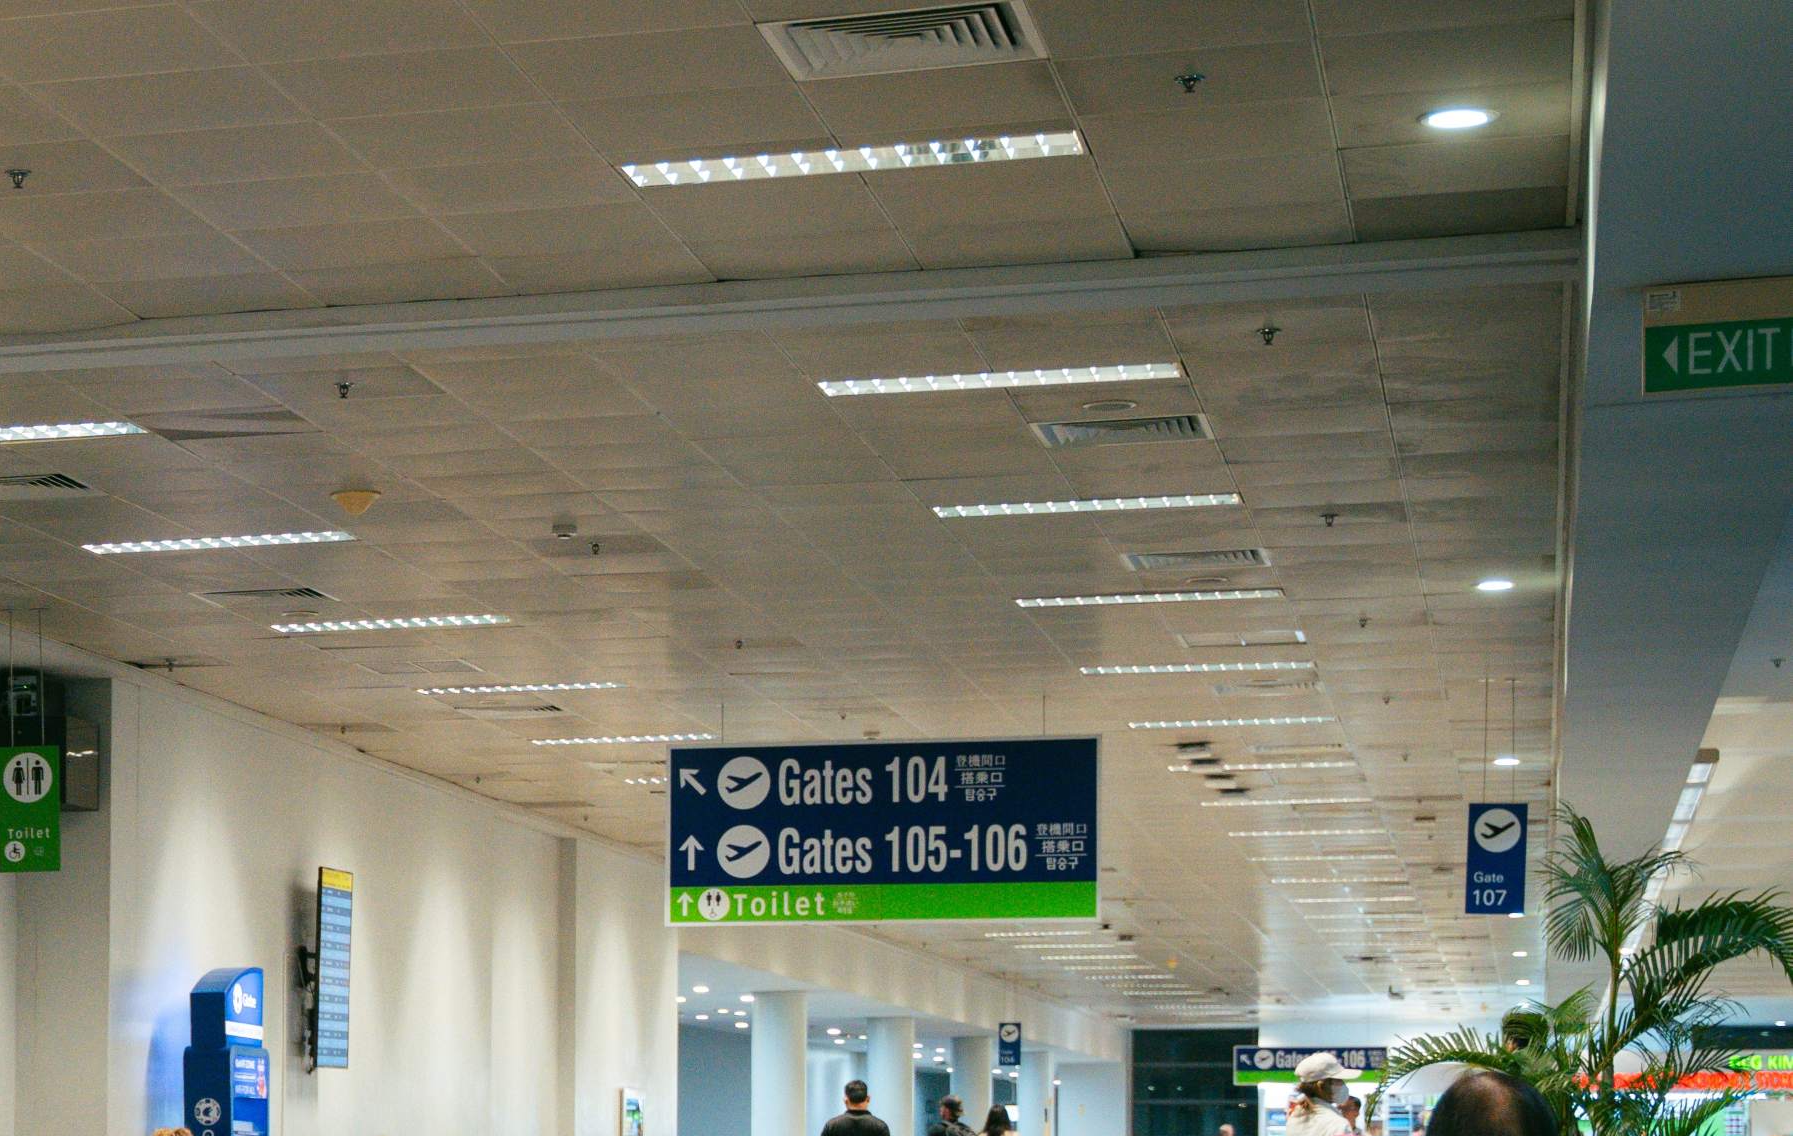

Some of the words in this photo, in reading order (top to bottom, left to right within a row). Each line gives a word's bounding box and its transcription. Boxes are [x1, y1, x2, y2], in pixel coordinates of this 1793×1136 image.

[1688, 327, 1781, 375] EXIT
[778, 757, 873, 806] Gates
[885, 755, 948, 803] 104
[7, 827, 50, 839] Toilet
[778, 826, 873, 875] Gates
[885, 823, 1027, 872] 105-106
[1473, 871, 1504, 883] Gate
[734, 891, 825, 916] Toilet
[1473, 889, 1507, 906] 107
